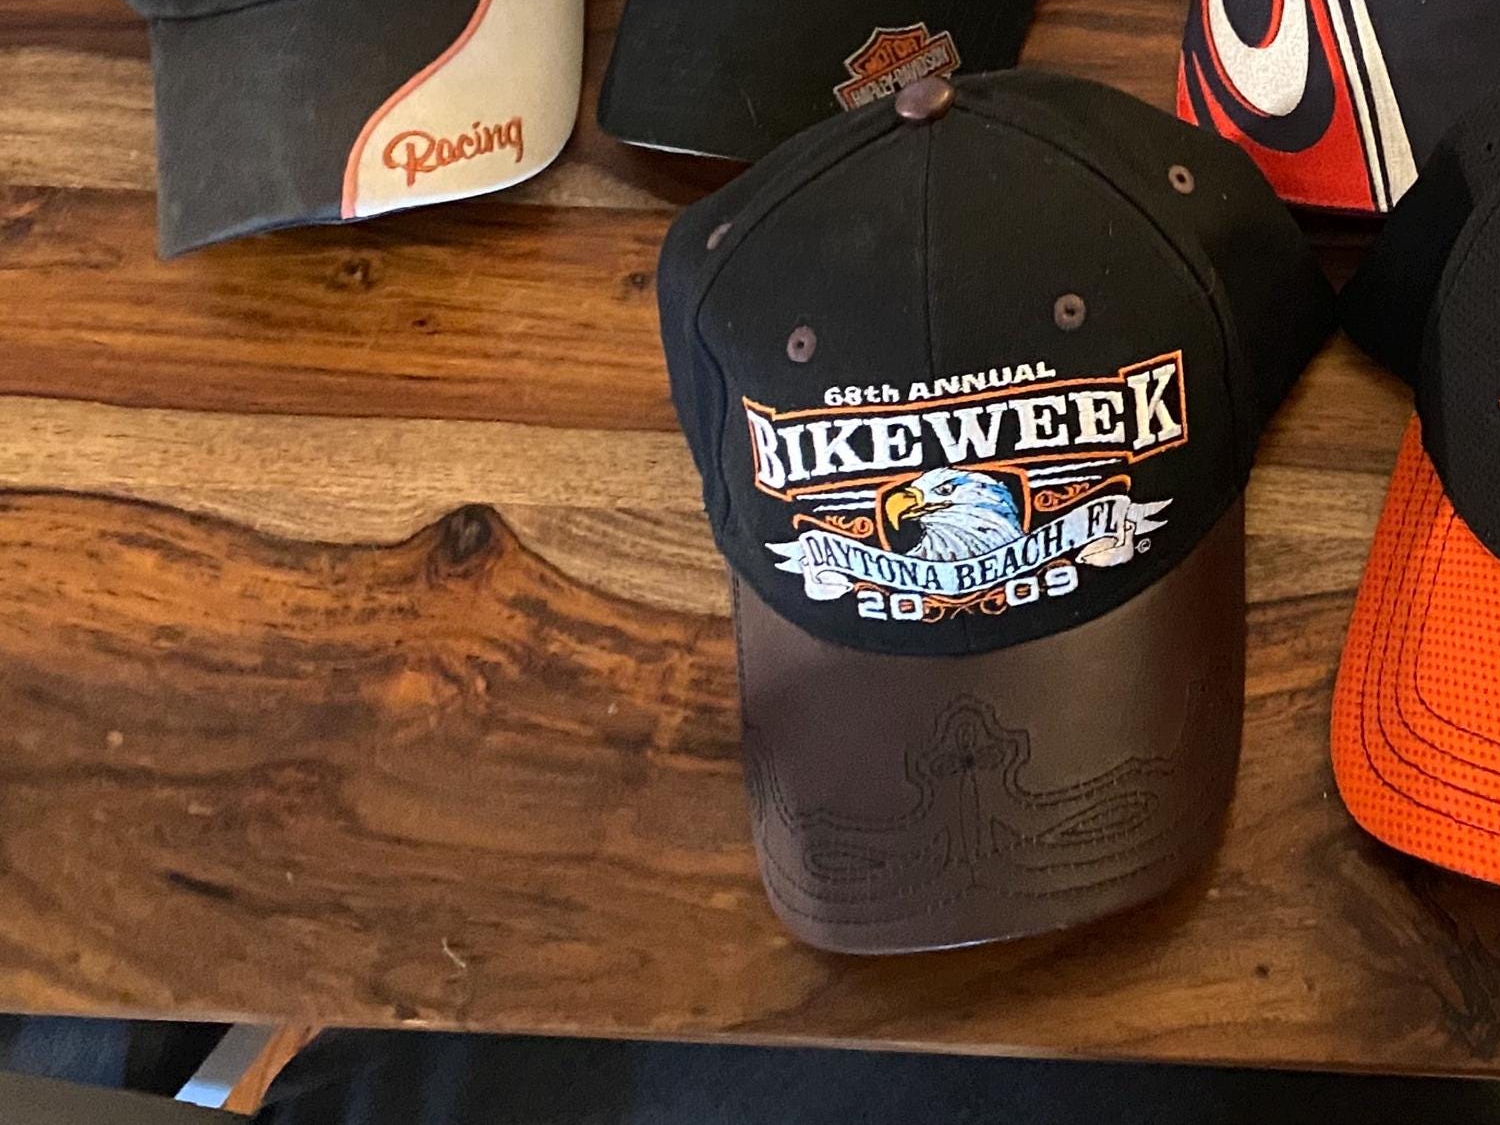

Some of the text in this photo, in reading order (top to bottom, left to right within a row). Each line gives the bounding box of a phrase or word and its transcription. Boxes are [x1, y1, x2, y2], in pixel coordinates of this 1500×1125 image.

[382, 117, 523, 187] Racing
[823, 361, 1057, 407] 68th ANNUAL
[804, 533, 942, 591] DAYTONA
[1086, 498, 1118, 539] FL
